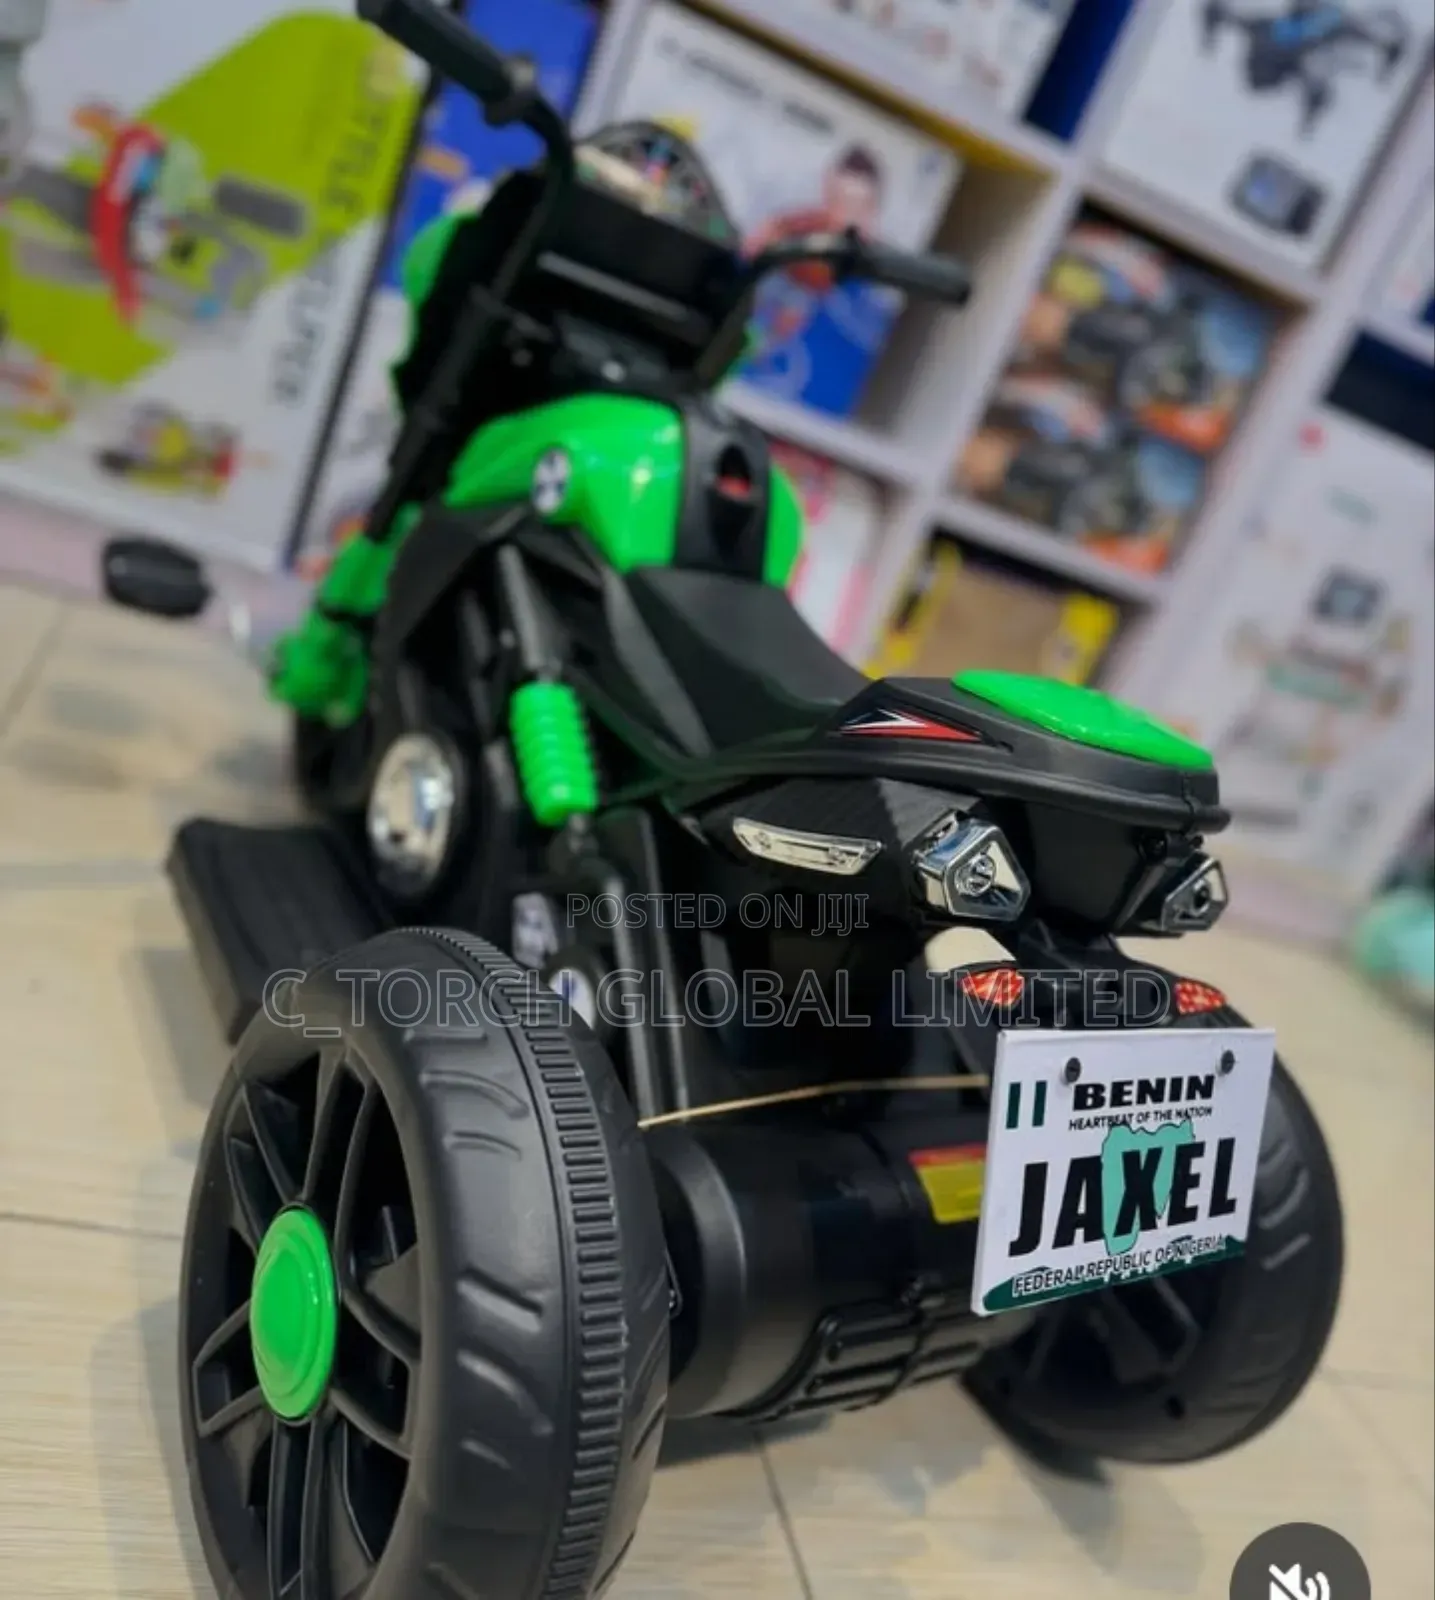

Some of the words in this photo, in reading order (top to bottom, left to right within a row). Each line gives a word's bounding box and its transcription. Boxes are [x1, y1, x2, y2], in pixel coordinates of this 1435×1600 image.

[1072, 1074, 1215, 1111] BENIN
[1068, 1113, 1133, 1131] HEARTBEAT
[1136, 1112, 1151, 1123] OF
[1153, 1110, 1174, 1120] THE
[1175, 1106, 1212, 1120] NATION
[1008, 1137, 1237, 1257] JAXEL
[1014, 1265, 1084, 1295] FEDERAL
[1086, 1251, 1151, 1278] REPUBLIC
[1155, 1246, 1173, 1262] OF
[1174, 1236, 1226, 1256] NIGERIA
